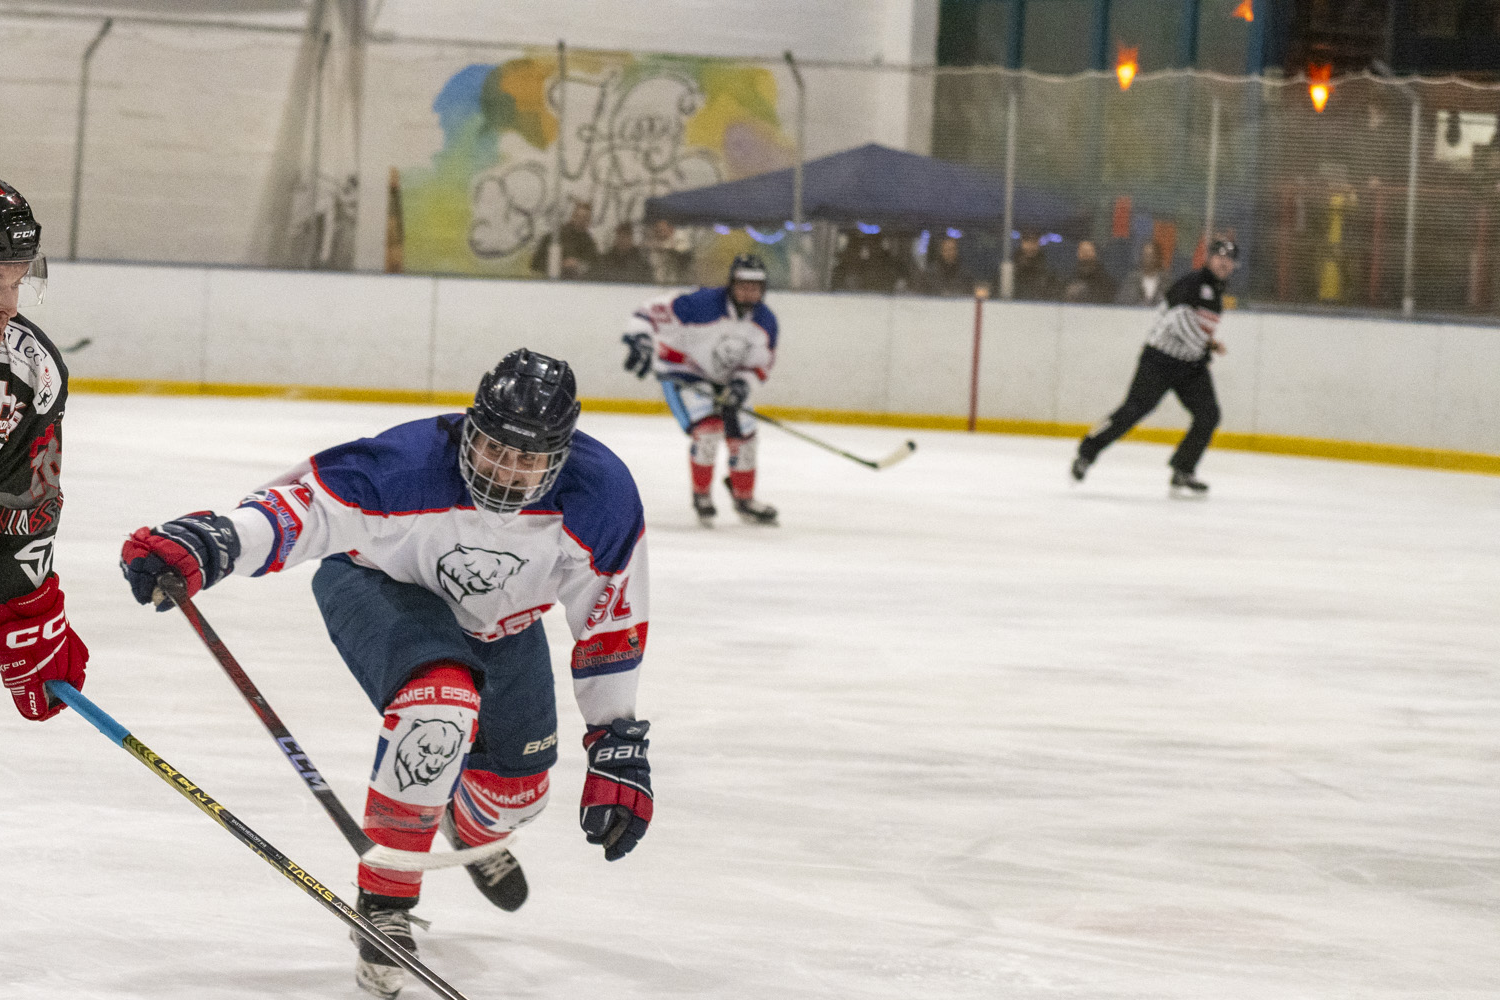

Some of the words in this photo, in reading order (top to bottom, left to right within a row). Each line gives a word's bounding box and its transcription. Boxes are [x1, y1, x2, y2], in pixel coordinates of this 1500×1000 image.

[12, 228, 37, 240] CCM
[5, 609, 70, 650] CC
[286, 860, 336, 902] TACKS
